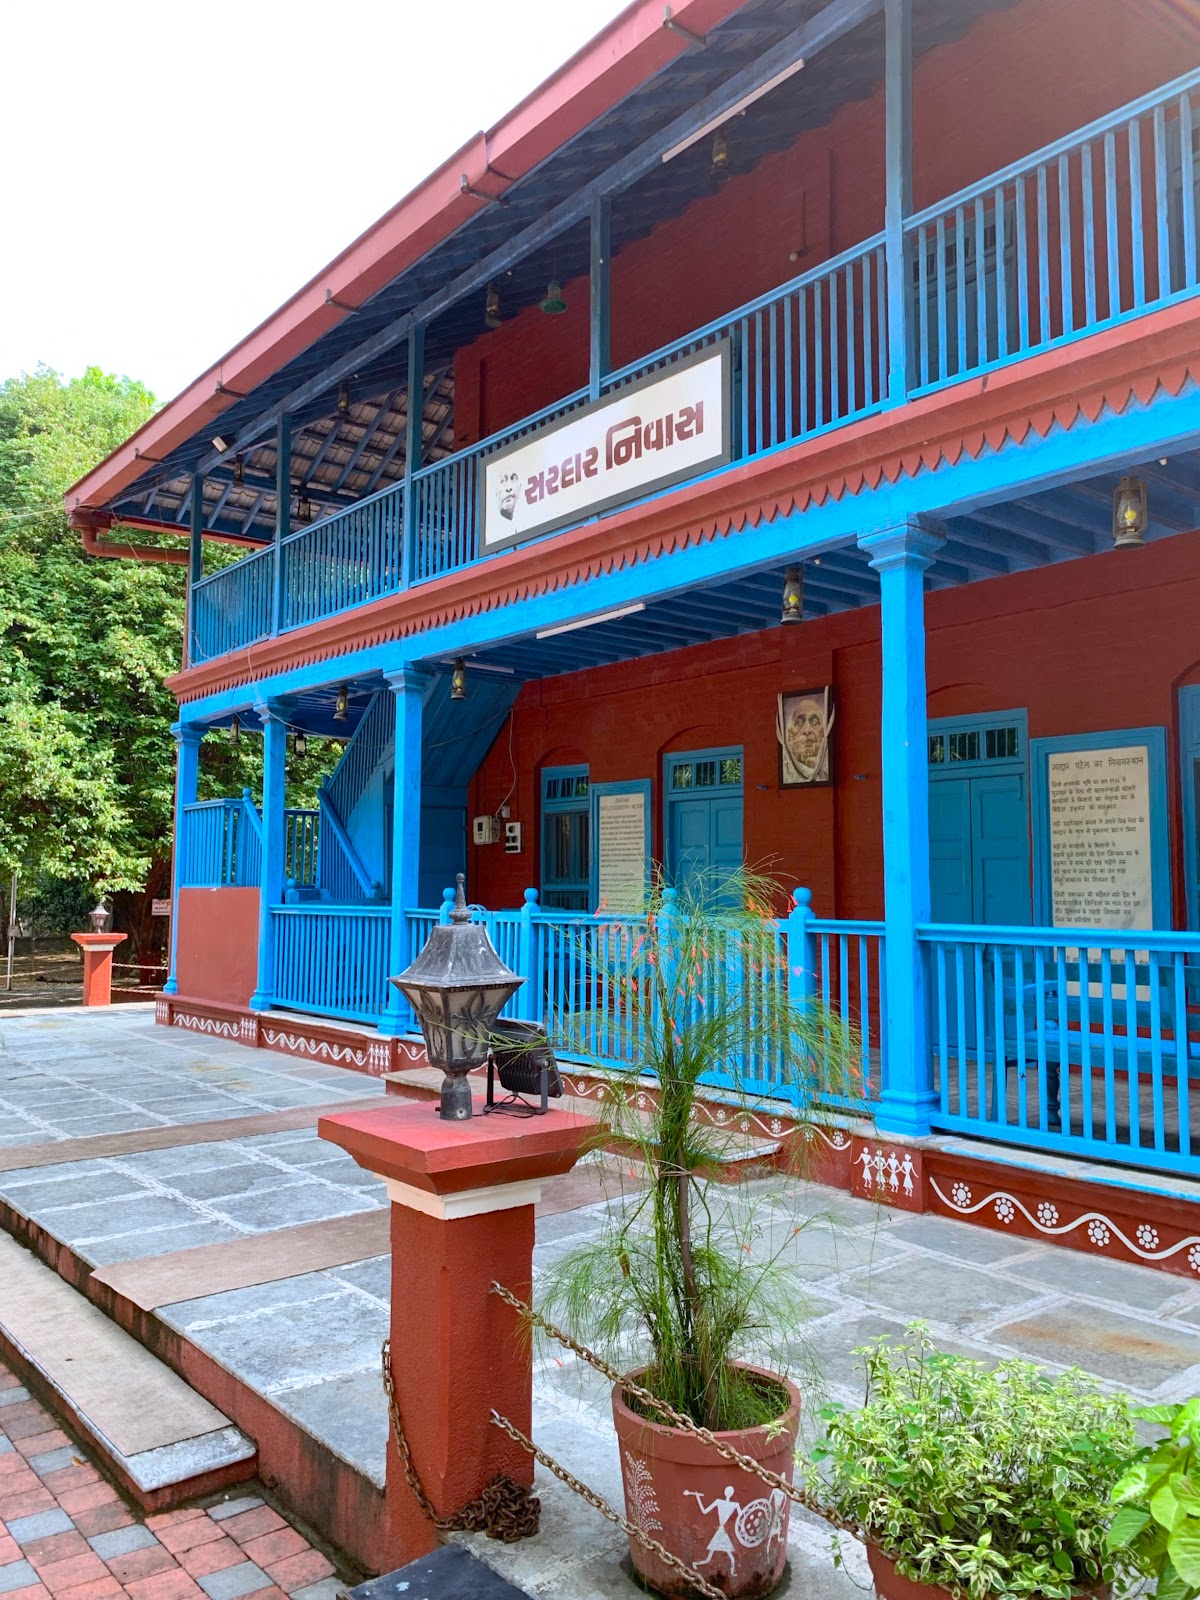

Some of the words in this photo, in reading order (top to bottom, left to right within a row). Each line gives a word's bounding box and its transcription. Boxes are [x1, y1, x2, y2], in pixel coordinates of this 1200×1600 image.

[525, 446, 599, 505] સરદાર
[605, 400, 704, 471] નિવાસ
[1075, 760, 1090, 769] पटेल
